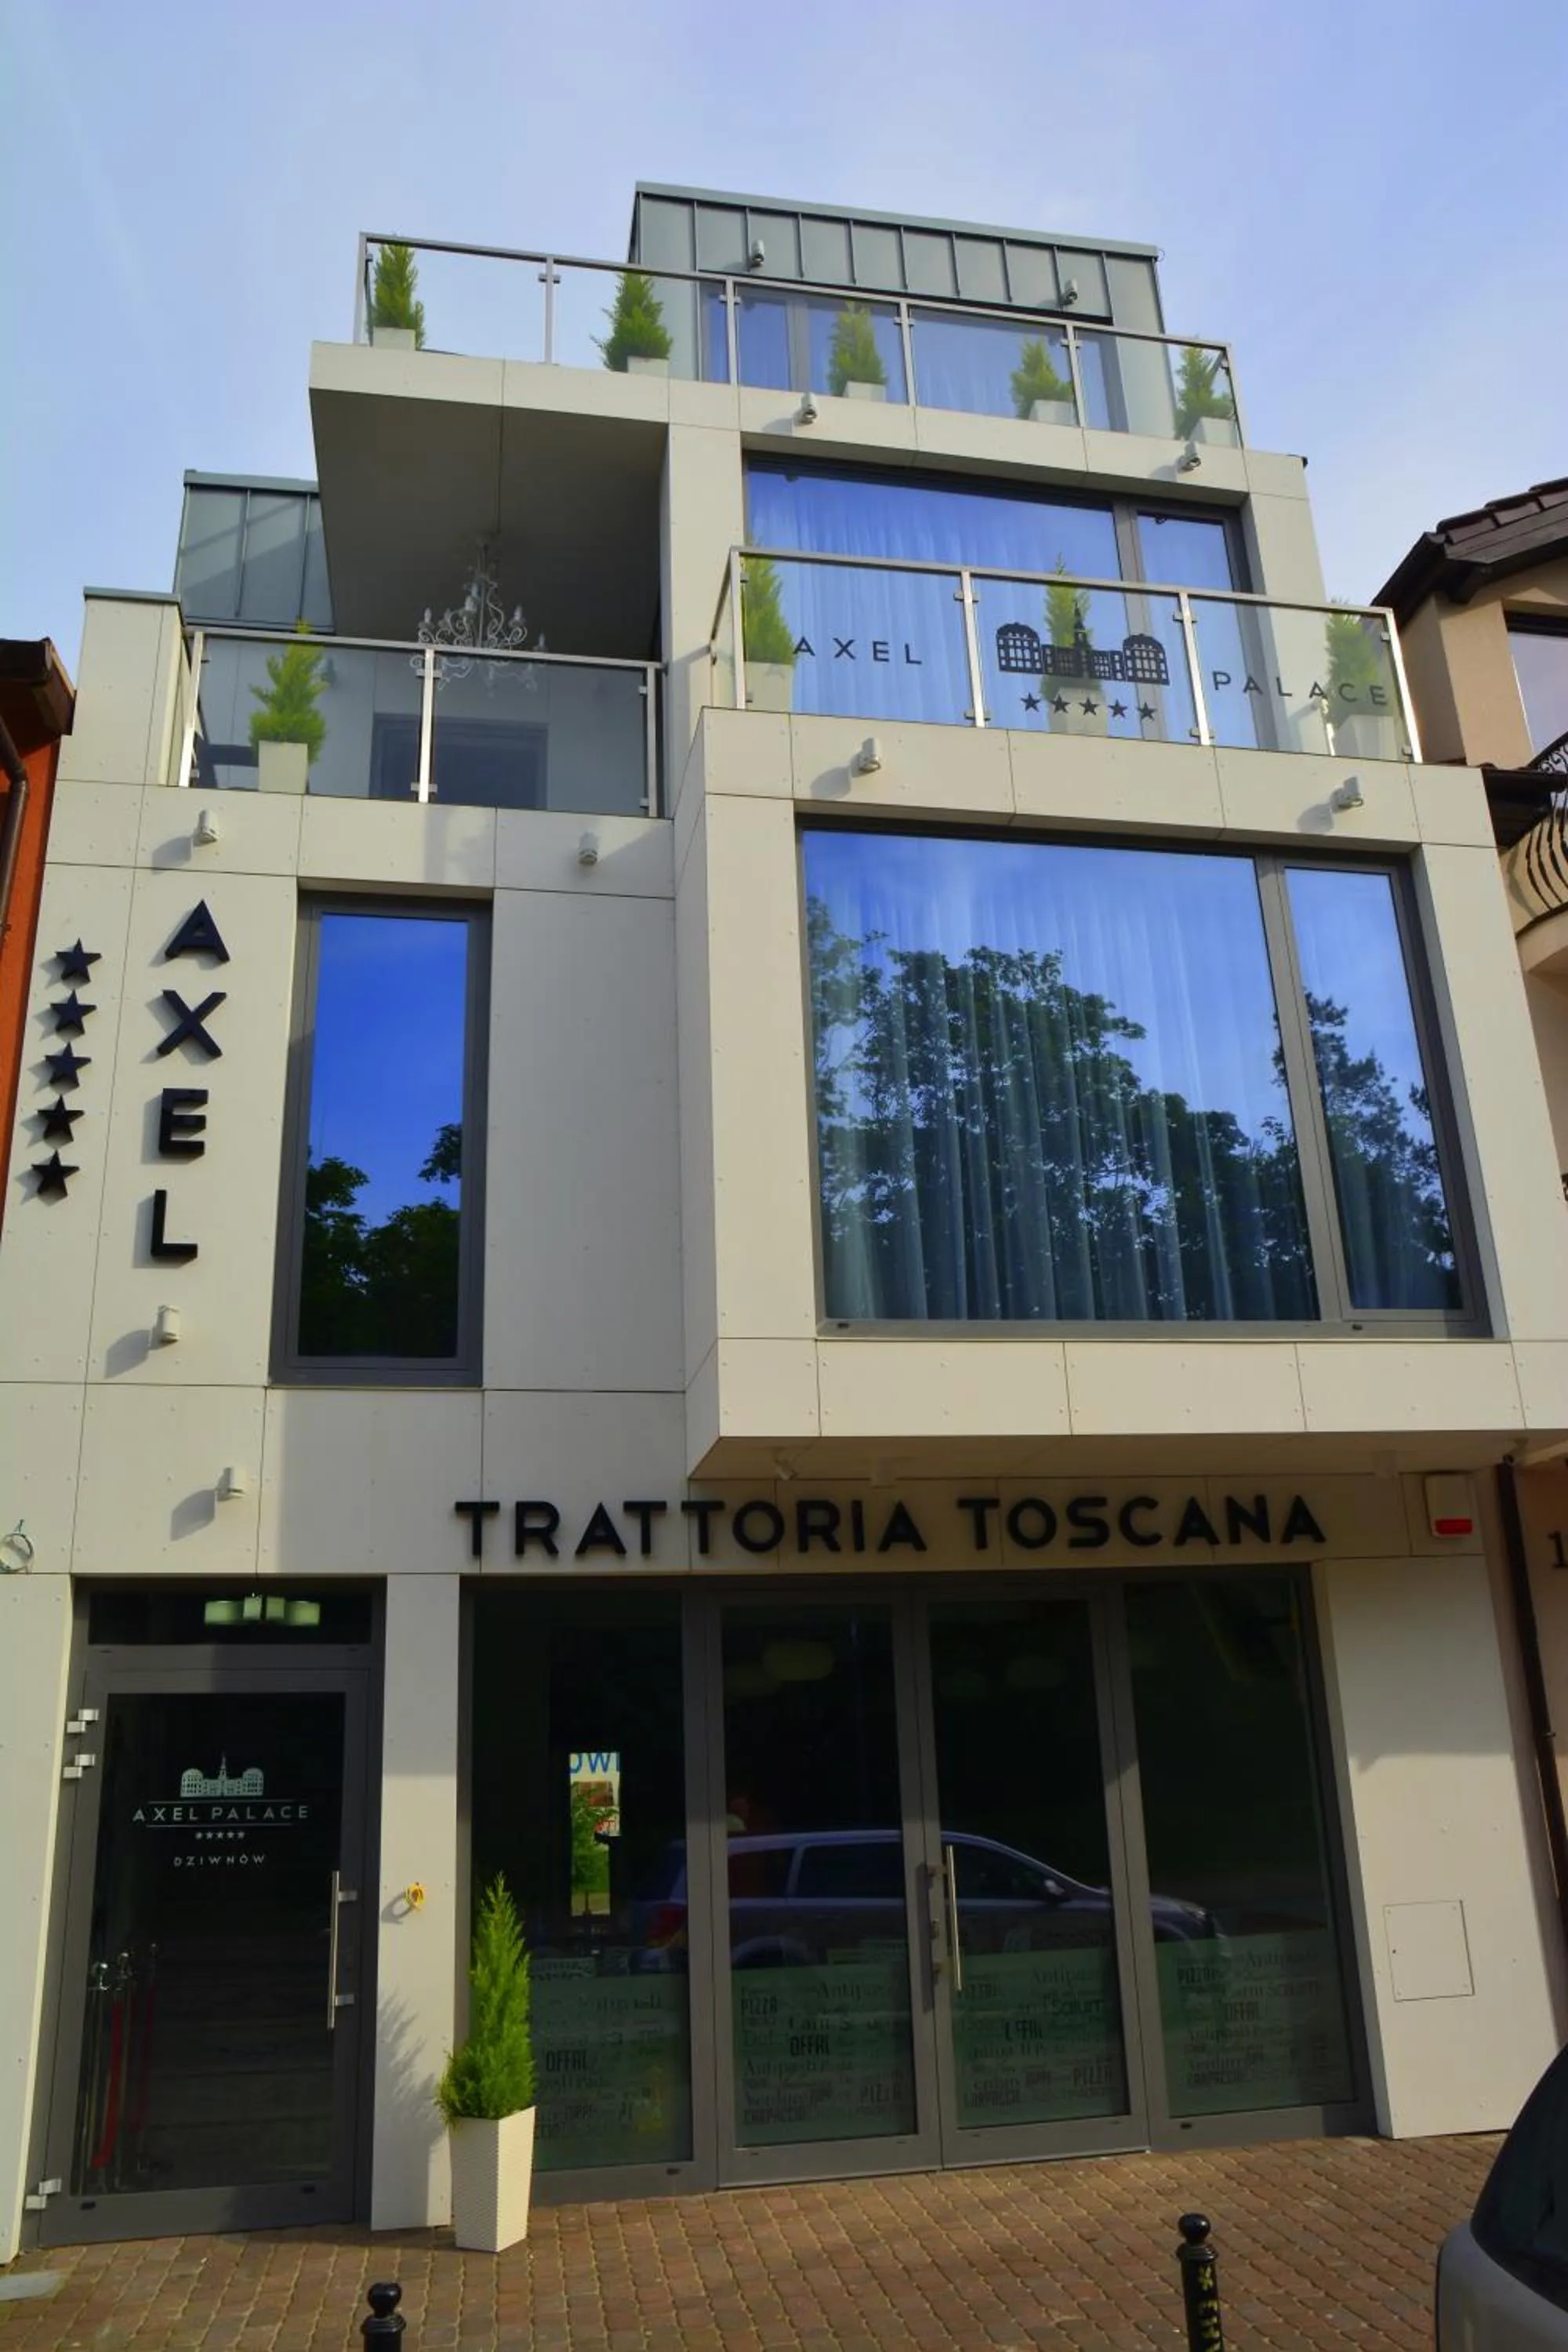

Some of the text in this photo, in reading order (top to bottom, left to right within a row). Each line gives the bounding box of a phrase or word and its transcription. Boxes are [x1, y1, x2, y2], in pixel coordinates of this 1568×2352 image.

[793, 636, 1388, 706] AXEL PALACE
[151, 899, 230, 1261] AXEL
[455, 1494, 1327, 1559] TRATTORIA TOSCANA
[132, 1806, 309, 1822] AXEL PALACE
[173, 1853, 266, 1867] DZIWNÓW
